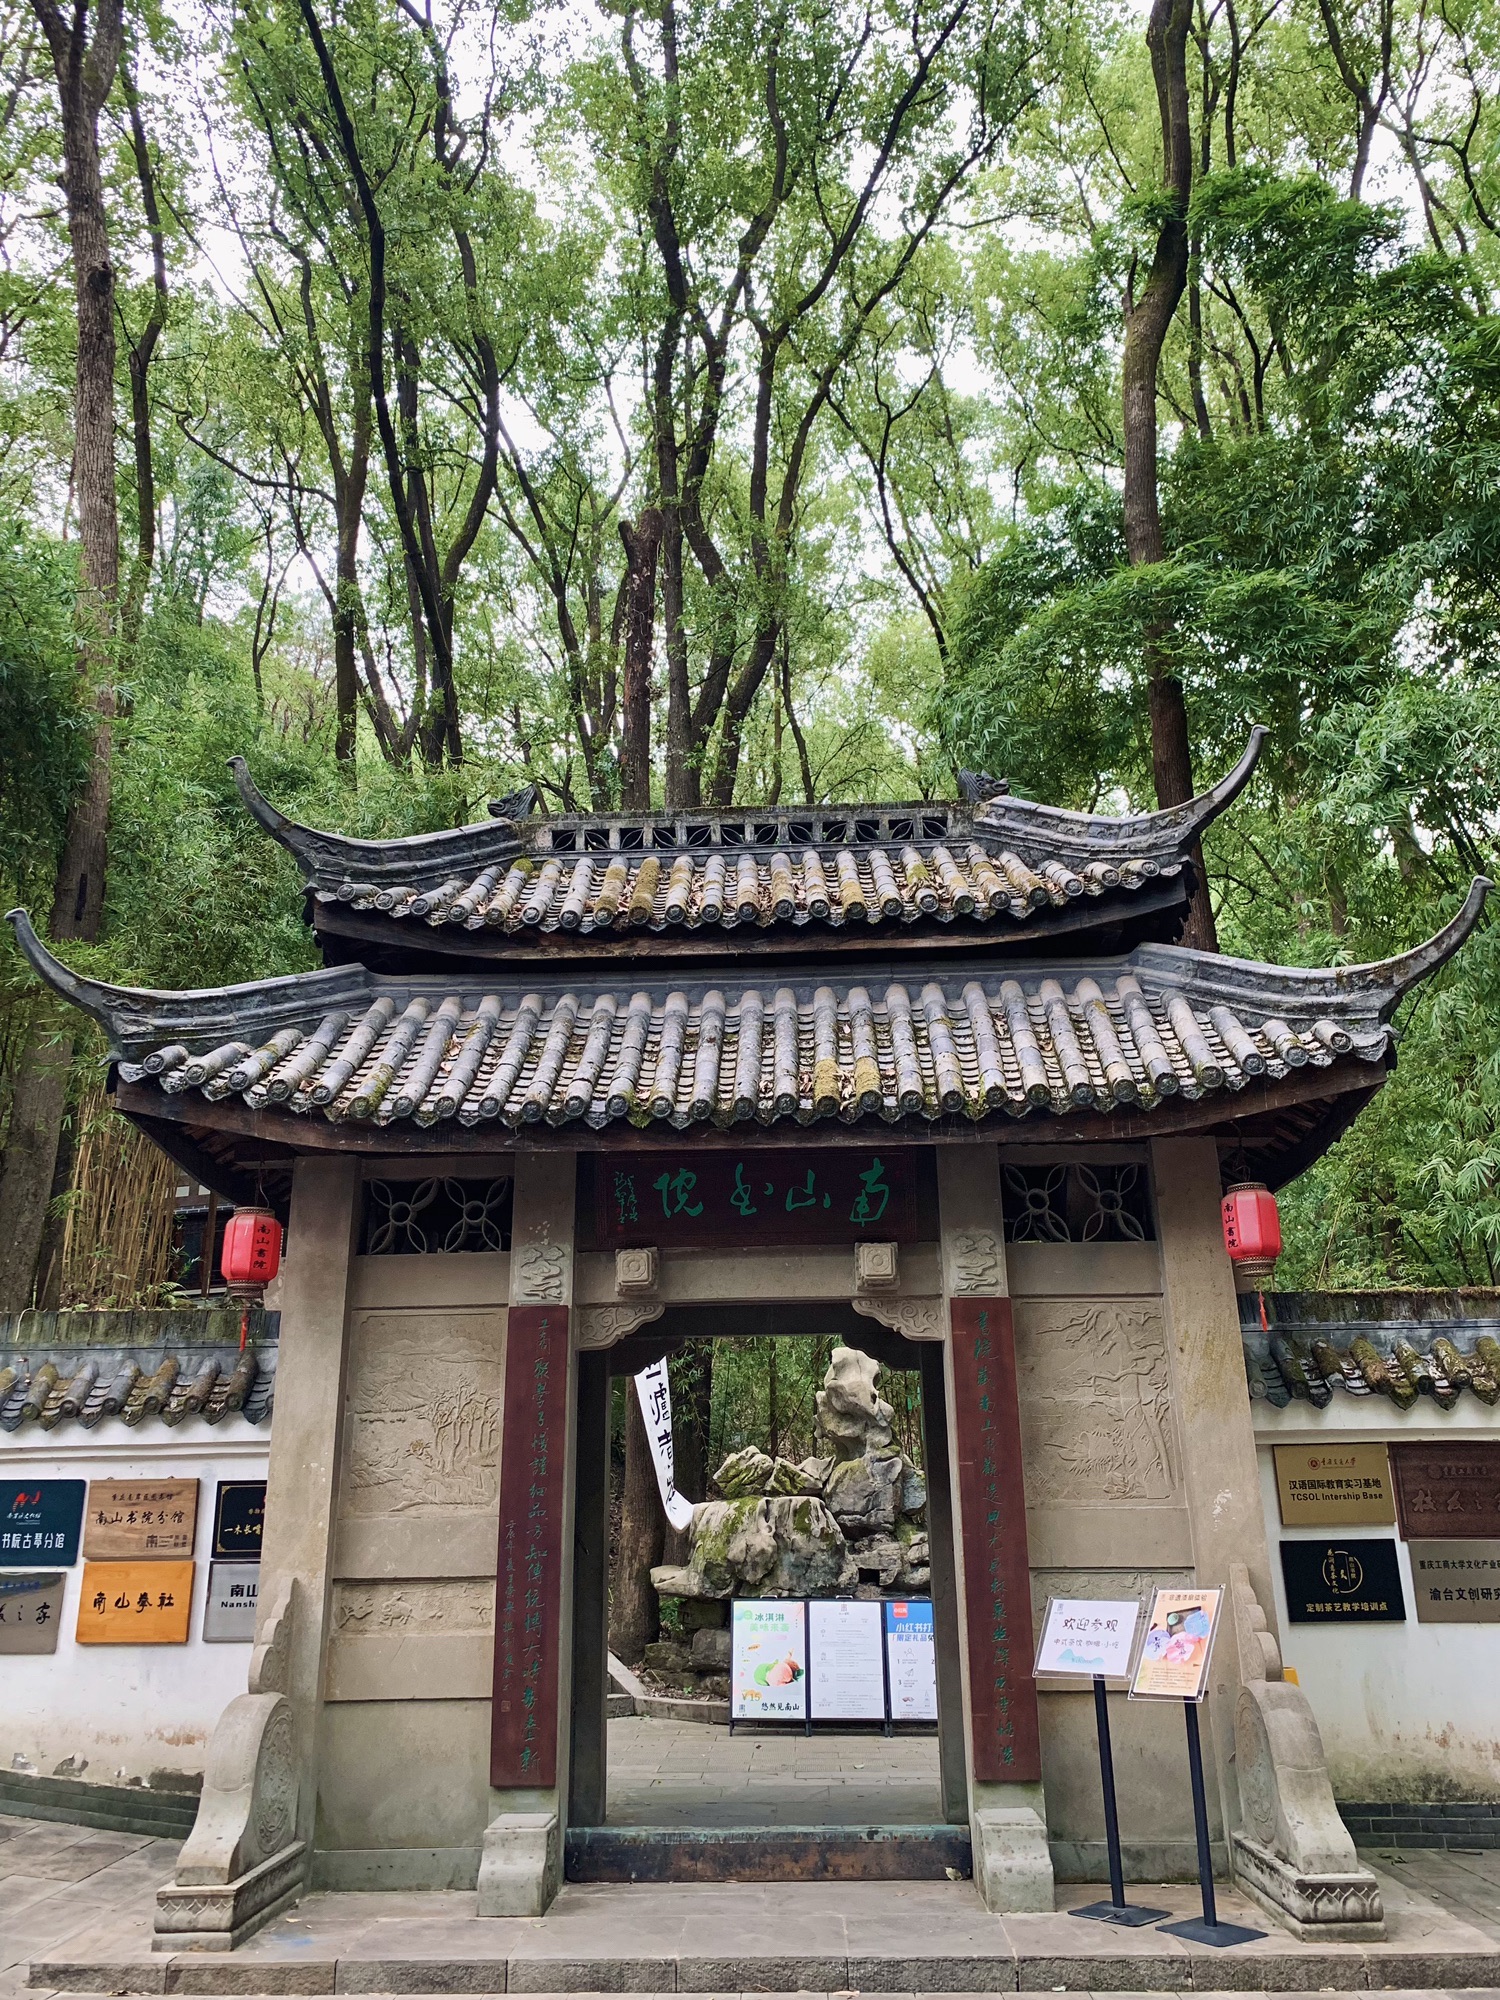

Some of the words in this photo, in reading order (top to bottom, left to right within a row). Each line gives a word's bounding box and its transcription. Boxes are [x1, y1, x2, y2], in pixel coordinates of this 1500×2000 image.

[1288, 1478, 1382, 1490] 汉语国际教育实习基地
[1290, 1493, 1321, 1502] TCSOL
[1321, 1492, 1361, 1502] Intership
[1362, 1491, 1383, 1500] Base
[95, 1510, 185, 1526] 南山书院分馆
[1, 1532, 65, 1549] 书院古琴分馆
[220, 1600, 258, 1608] Nansh
[1306, 1601, 1388, 1614] 定制茶艺教学培训点
[754, 1612, 785, 1622] 冰淇淋
[895, 1622, 935, 1633] 小红书打
[1062, 1617, 1119, 1633] 欢迎参观
[760, 1702, 800, 1712] 悠然见南山
